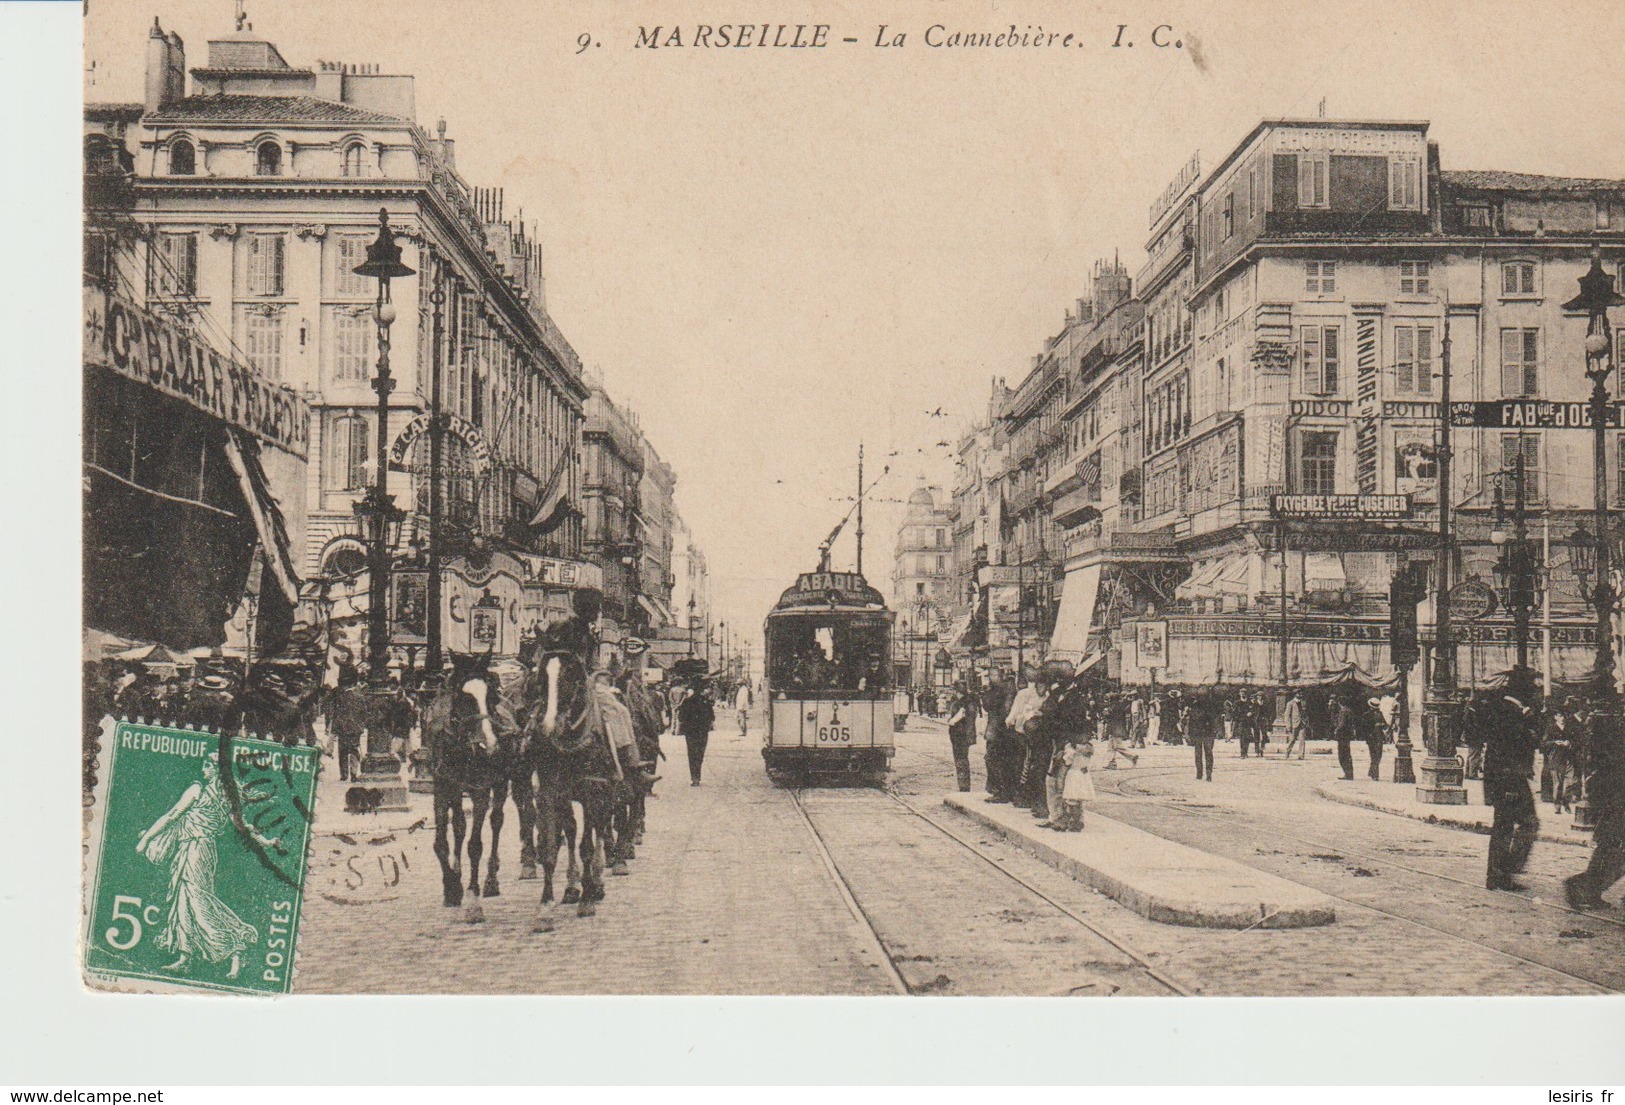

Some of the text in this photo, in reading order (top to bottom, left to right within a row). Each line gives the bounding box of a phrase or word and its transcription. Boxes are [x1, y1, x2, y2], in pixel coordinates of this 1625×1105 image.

[1357, 319, 1376, 407] ANNUAIRE
[1289, 401, 1353, 417] DIDOT
[448, 415, 491, 472] RICHE
[1358, 495, 1408, 511] CUSENIER
[800, 573, 863, 592] ABADIE
[819, 727, 850, 742] 605
[263, 900, 292, 982] POSTES
